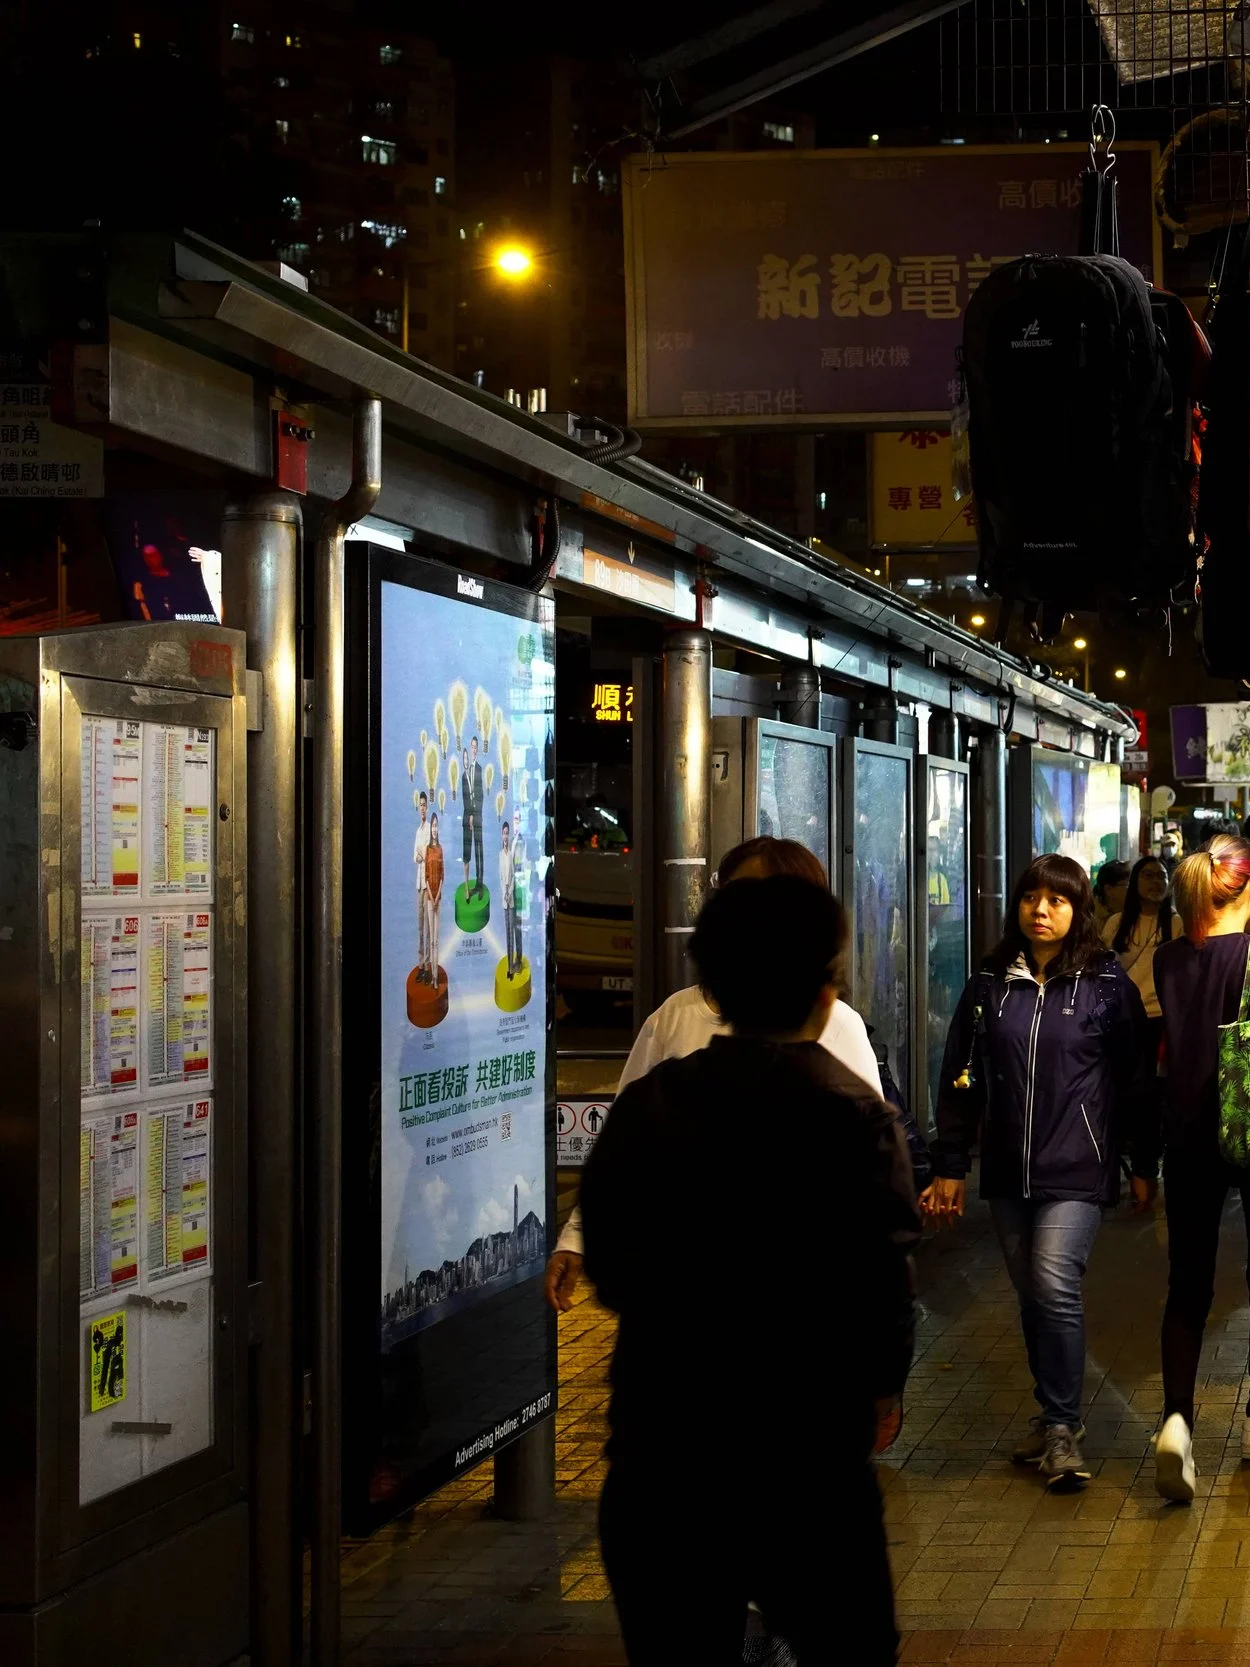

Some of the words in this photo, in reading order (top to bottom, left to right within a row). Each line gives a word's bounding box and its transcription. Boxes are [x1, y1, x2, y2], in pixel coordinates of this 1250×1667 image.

[820, 345, 911, 369] 高價收機
[1, 421, 40, 444] 頭角
[22, 448, 39, 457] Kok
[888, 485, 942, 511] 專營
[595, 709, 621, 721] SHUN
[398, 1063, 470, 1112] 正面看投訴
[475, 1050, 536, 1094] 共建好制度
[401, 1114, 426, 1131] Positive
[425, 1107, 452, 1124] Complaint
[452, 1101, 471, 1116] Culture
[472, 1098, 480, 1111] for
[480, 1094, 497, 1108] Better
[498, 1085, 533, 1103] Administration
[454, 1432, 494, 1468] Advertising
[494, 1417, 520, 1442] Hotline:
[521, 1402, 537, 1424] 2746
[536, 1392, 552, 1414] 8787
